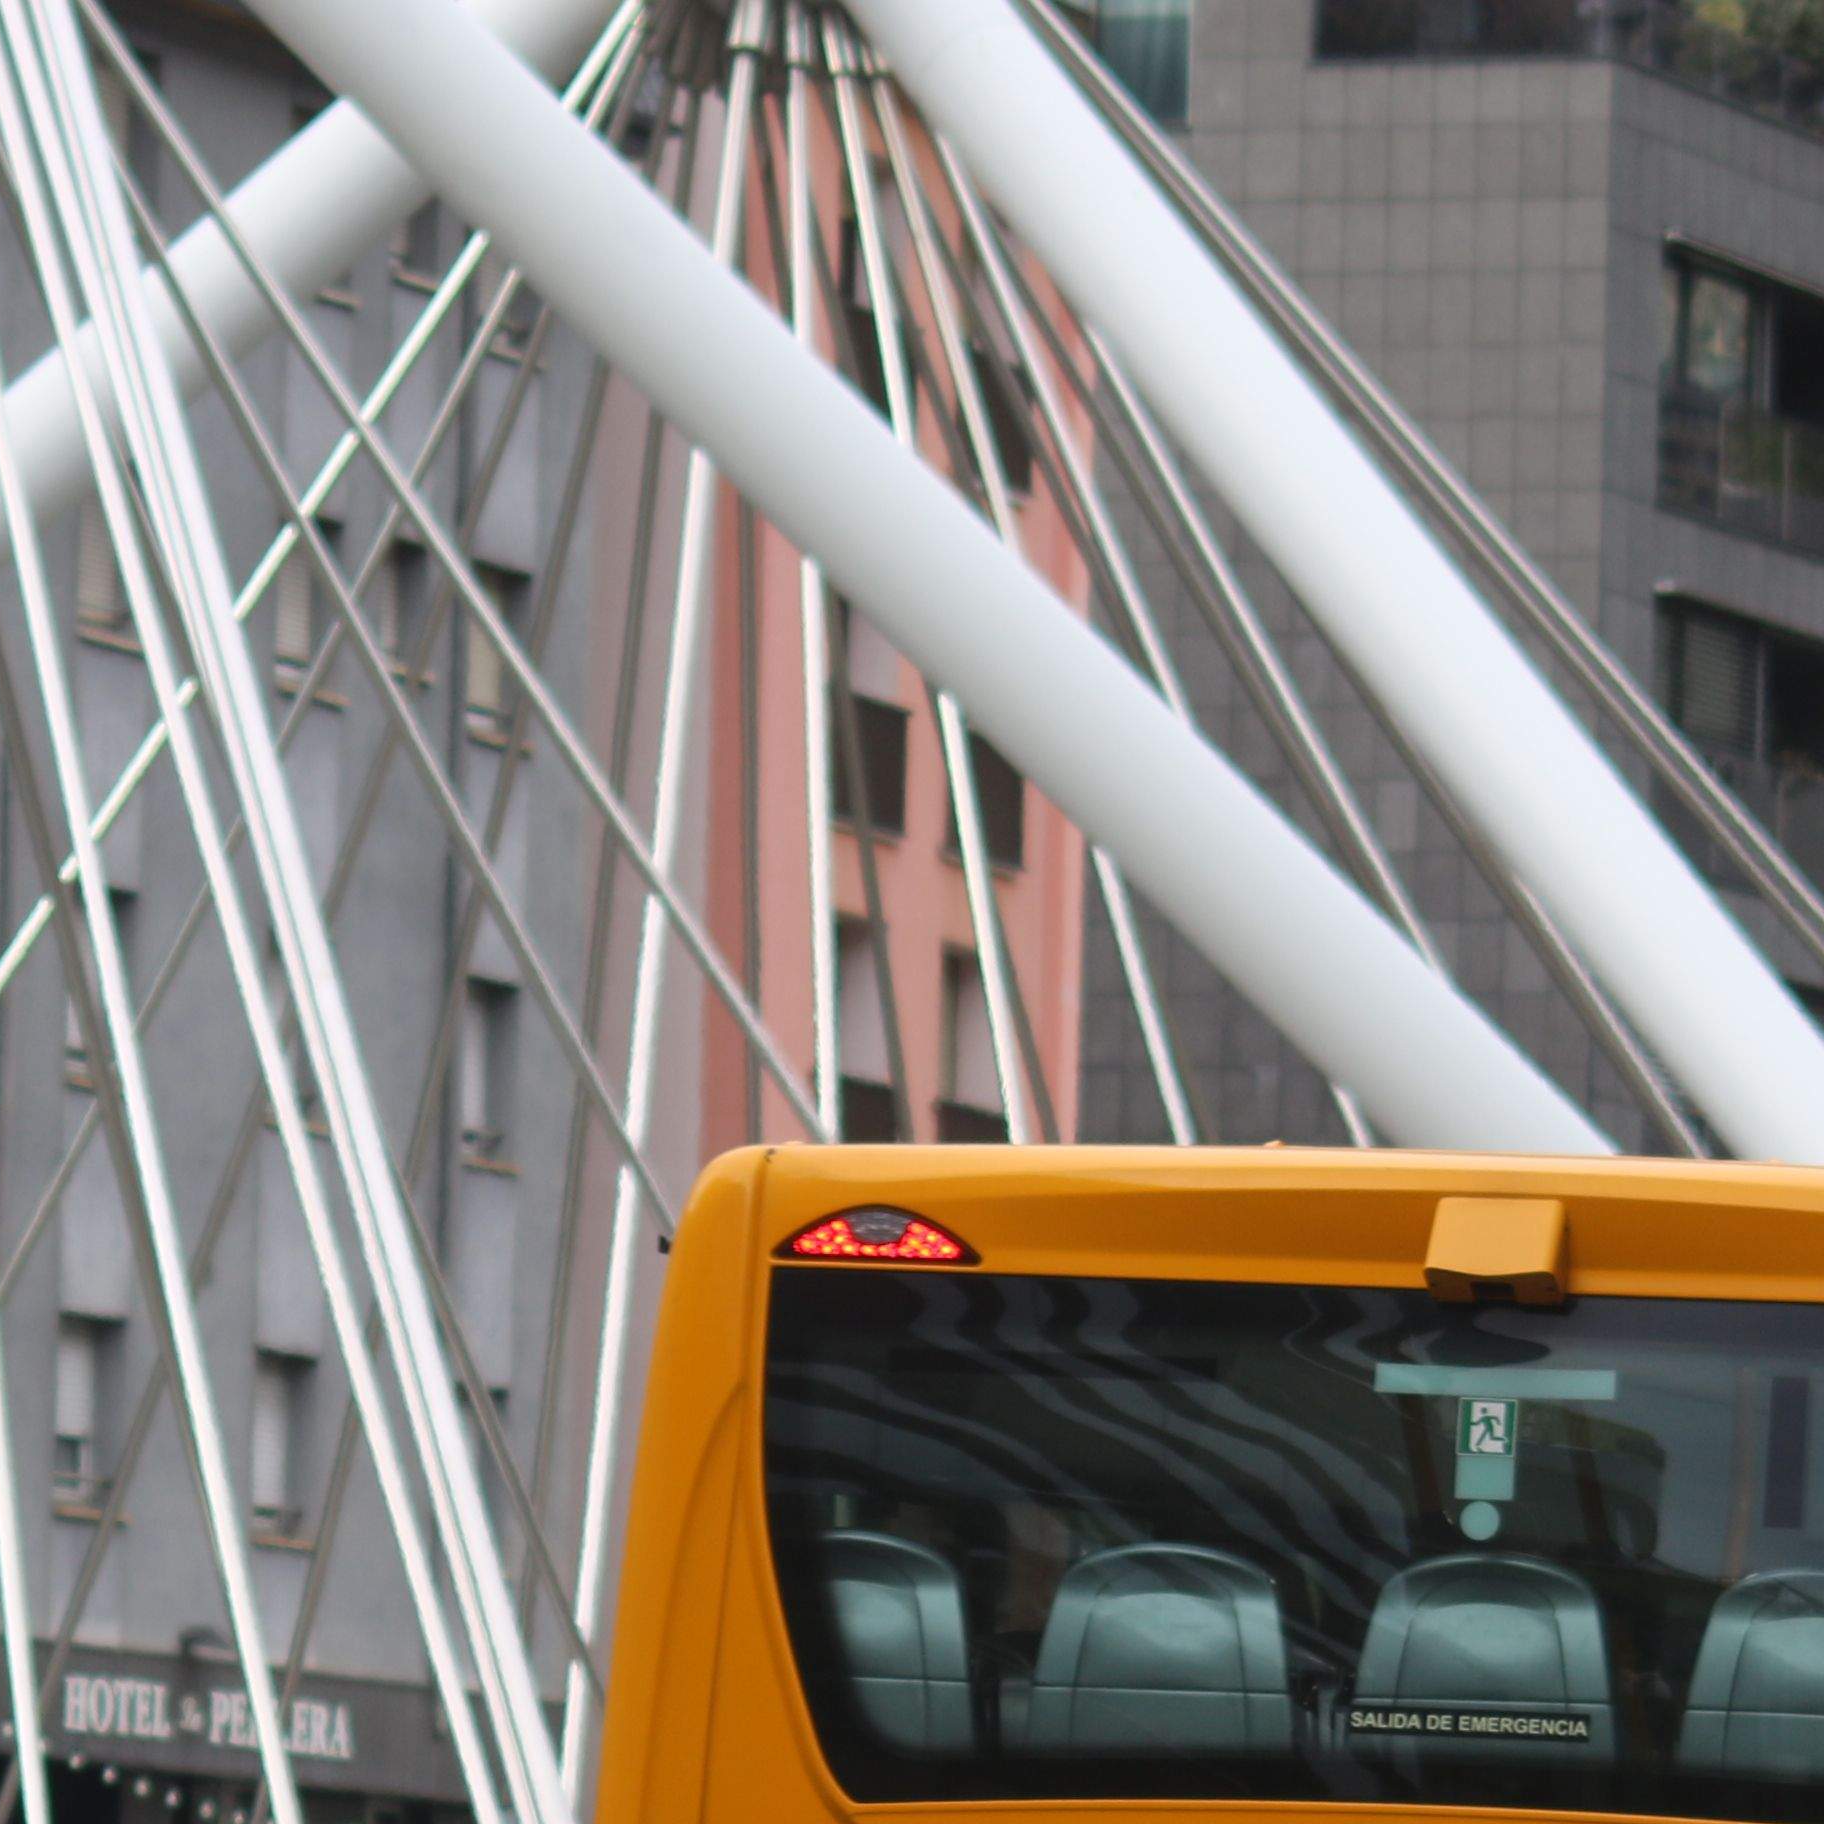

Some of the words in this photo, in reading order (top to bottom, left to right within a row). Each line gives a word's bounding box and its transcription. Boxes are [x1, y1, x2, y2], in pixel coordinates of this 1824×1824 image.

[65, 1676, 172, 1740] HOTEL
[210, 1690, 353, 1760] PEERA
[1350, 1711, 1421, 1730] SALIDA
[1426, 1714, 1453, 1731] DE
[1458, 1715, 1588, 1738] EMERGENCIA
